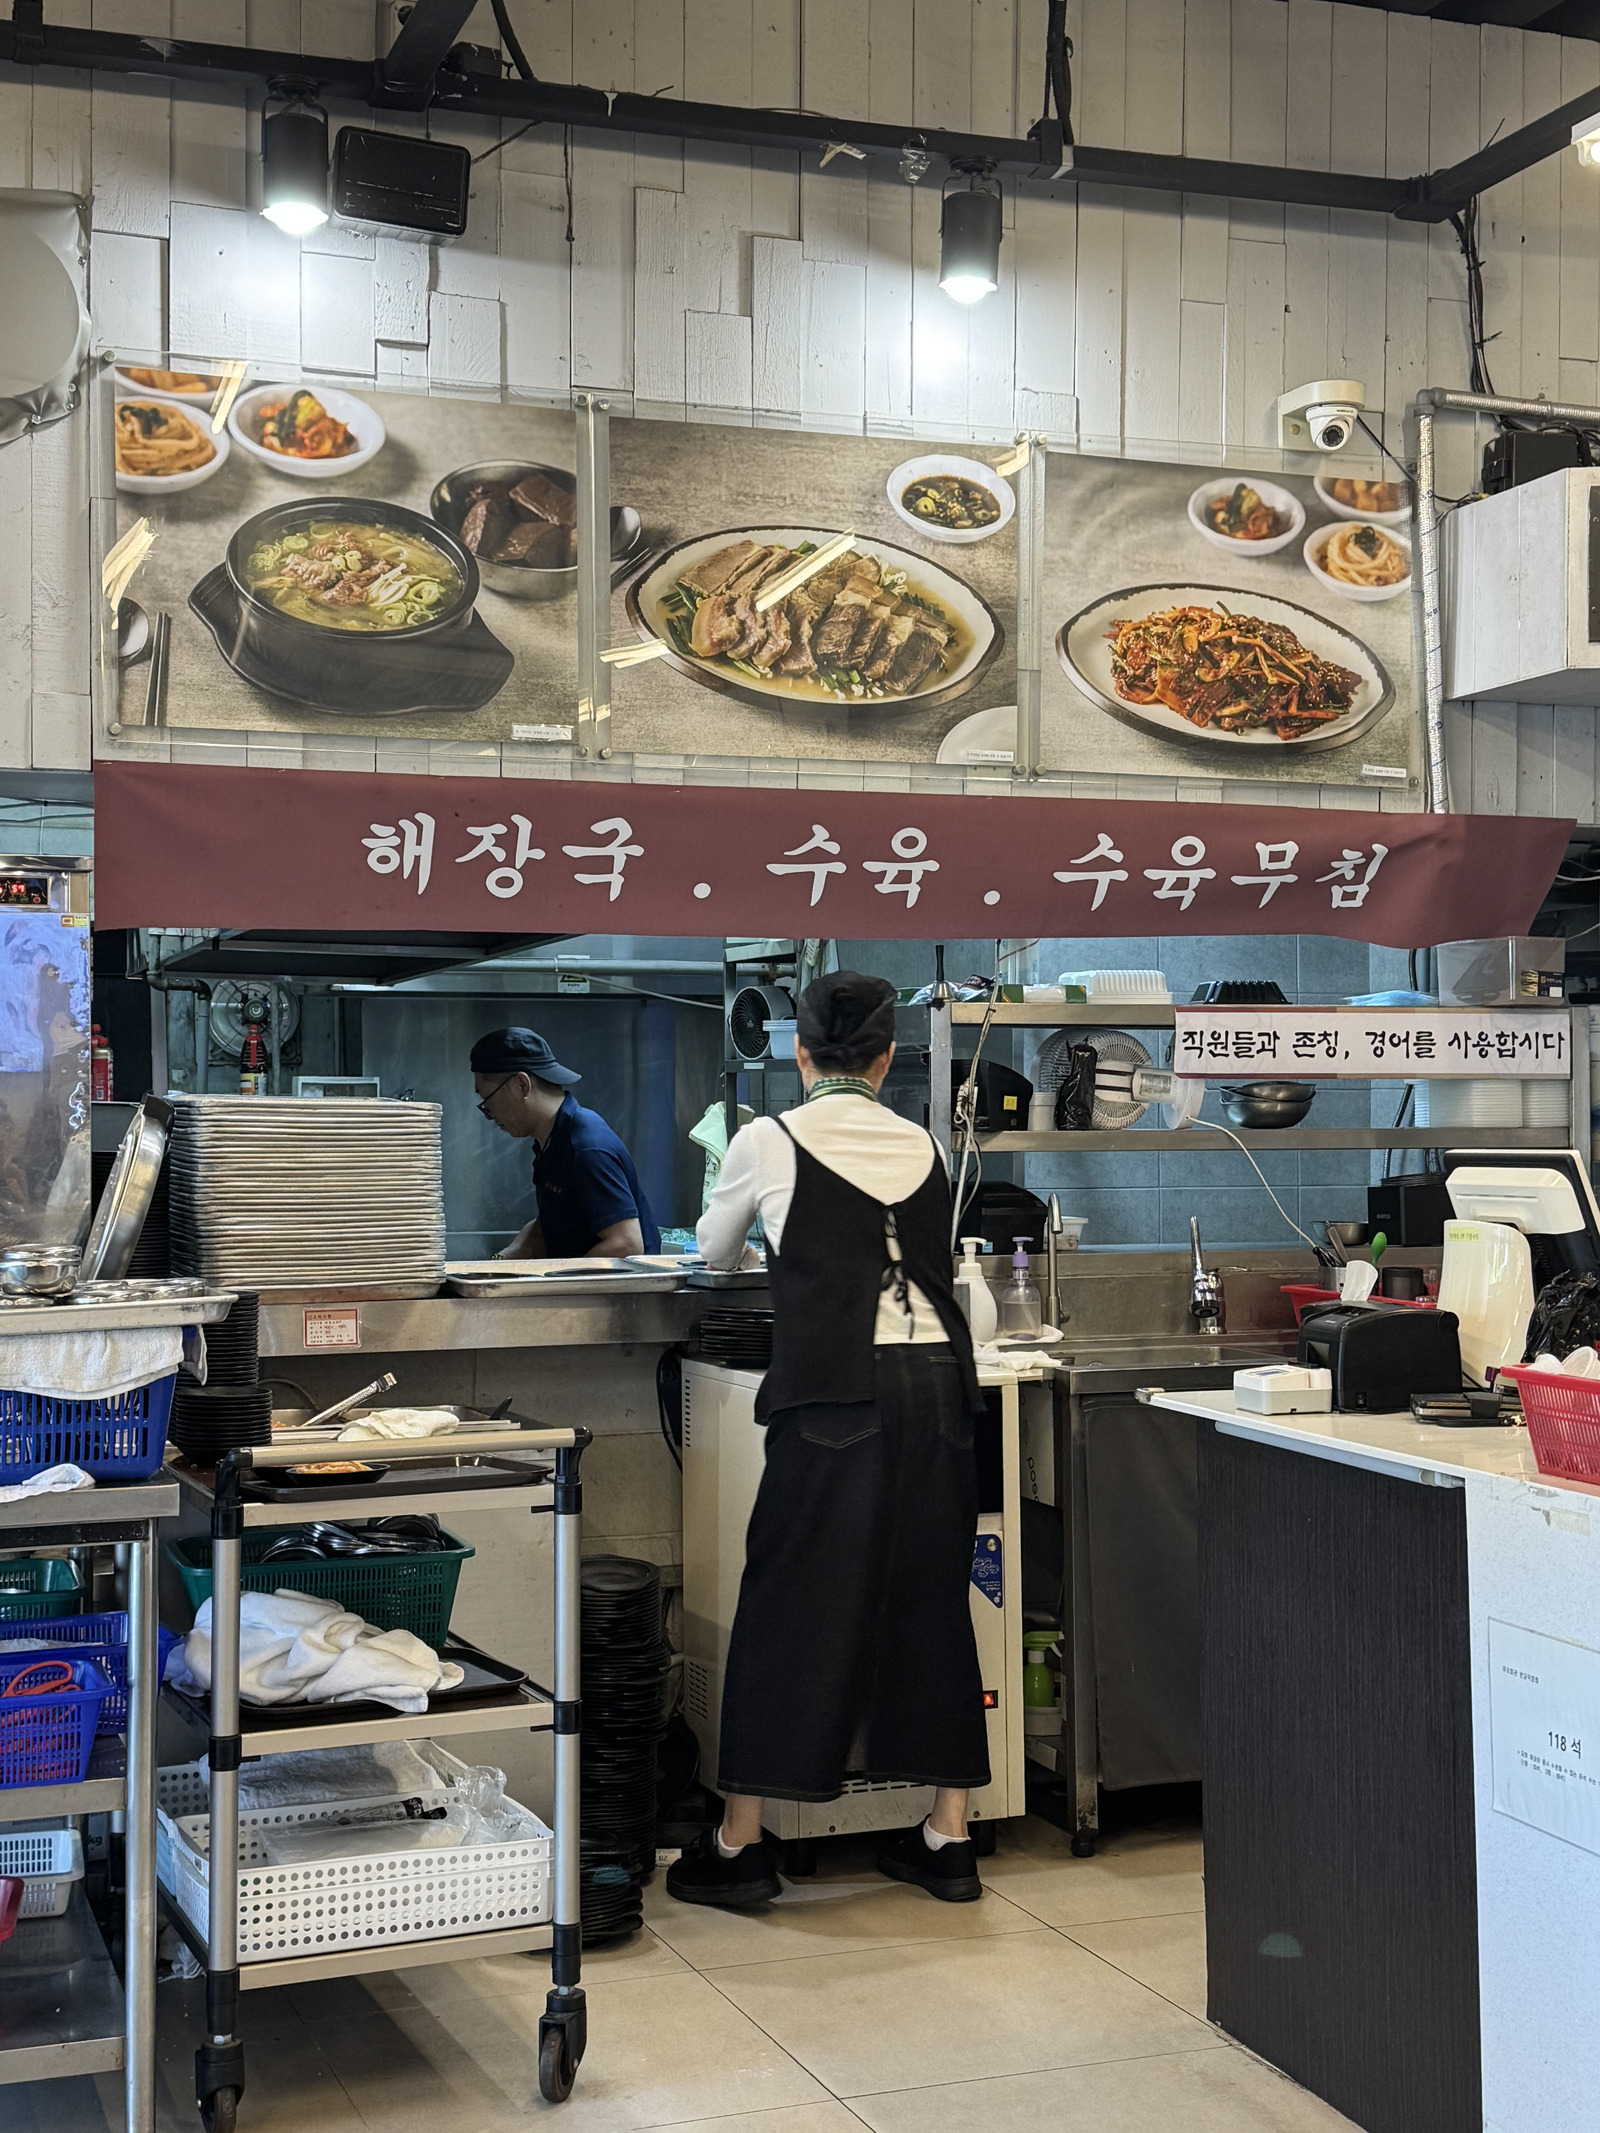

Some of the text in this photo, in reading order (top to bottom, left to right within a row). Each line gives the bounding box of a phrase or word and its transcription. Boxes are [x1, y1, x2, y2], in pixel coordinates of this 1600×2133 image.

[361, 812, 645, 902] 해장국
[765, 824, 940, 909] 수육
[1052, 832, 1389, 911] 수육무침
[1181, 1029, 1565, 1060] 직원들과 존칭, 경어를 사용합시다
[1548, 1731, 1581, 1760] 118 석
